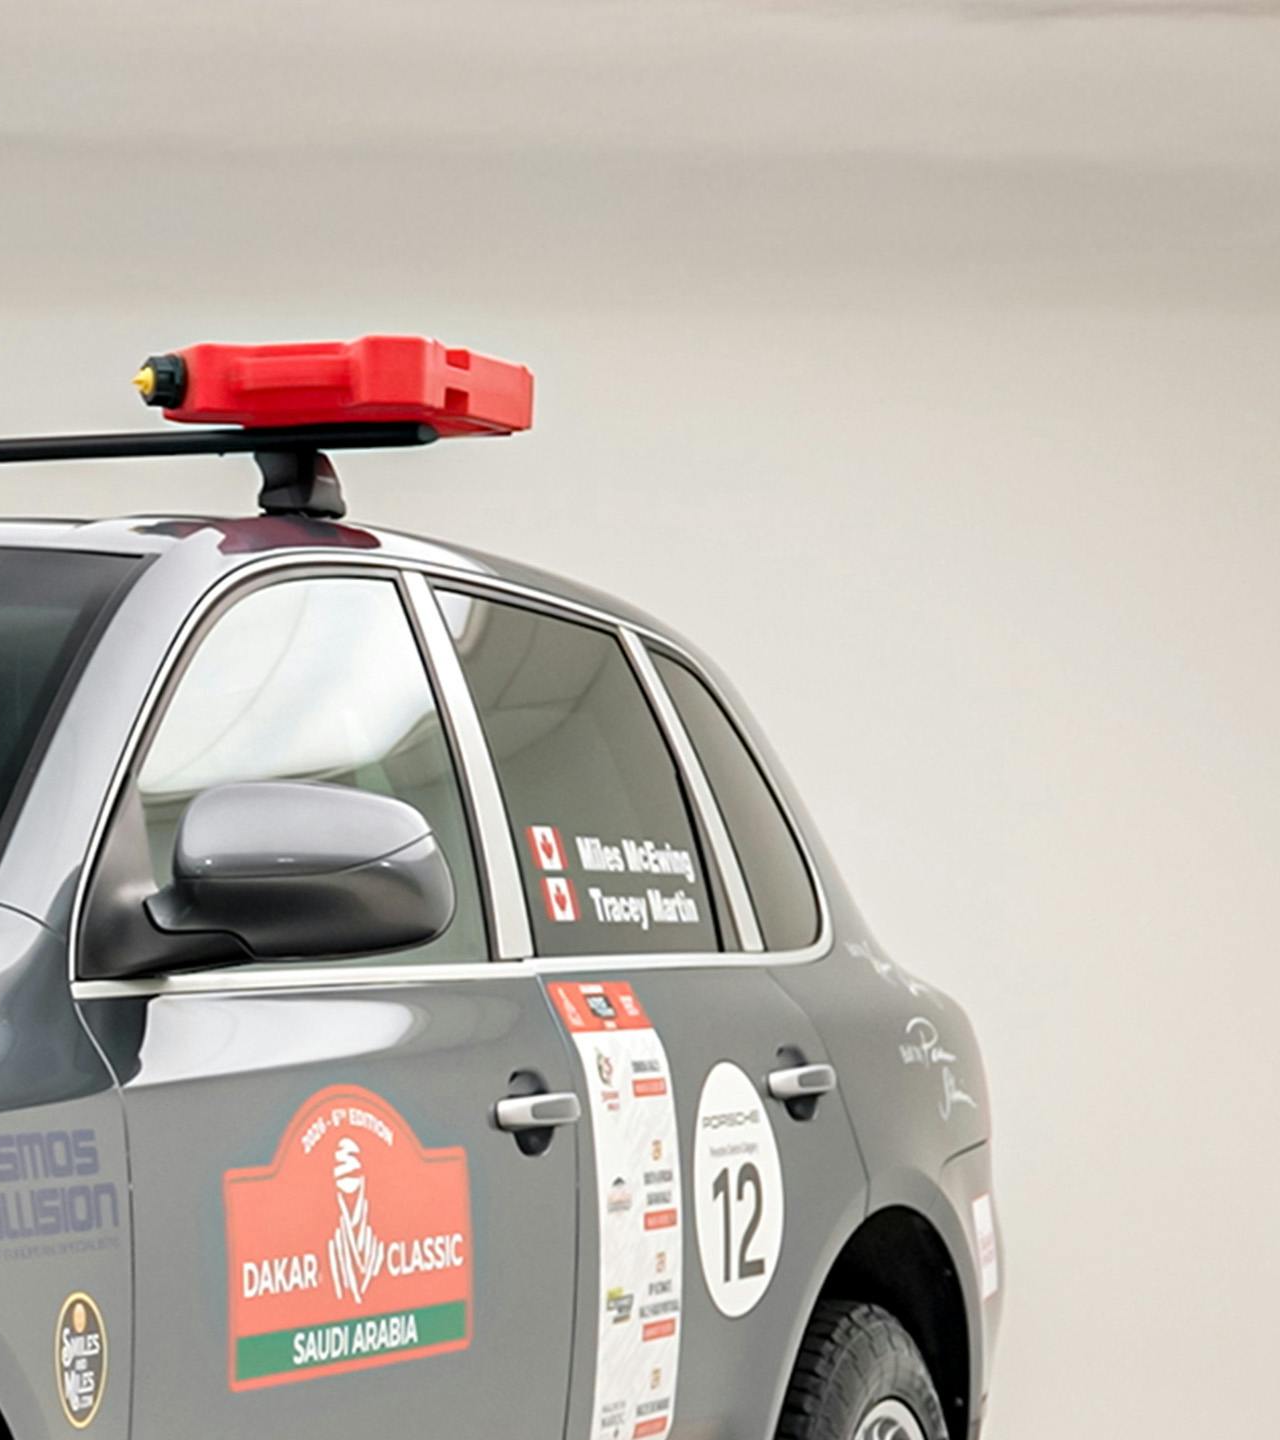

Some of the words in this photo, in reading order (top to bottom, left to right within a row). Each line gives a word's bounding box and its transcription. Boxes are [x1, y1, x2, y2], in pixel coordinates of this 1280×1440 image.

[575, 836, 625, 872] Miles
[621, 838, 695, 883] McEwing
[588, 887, 649, 930] Tracey
[646, 888, 700, 923] Martin
[702, 1109, 760, 1129] PORSCHE
[712, 1161, 765, 1283] 12
[242, 1253, 319, 1299] DAKAR
[386, 1233, 464, 1277] CLASSIC
[292, 1326, 350, 1365] SAUDI
[351, 1313, 418, 1355] ARABIA
